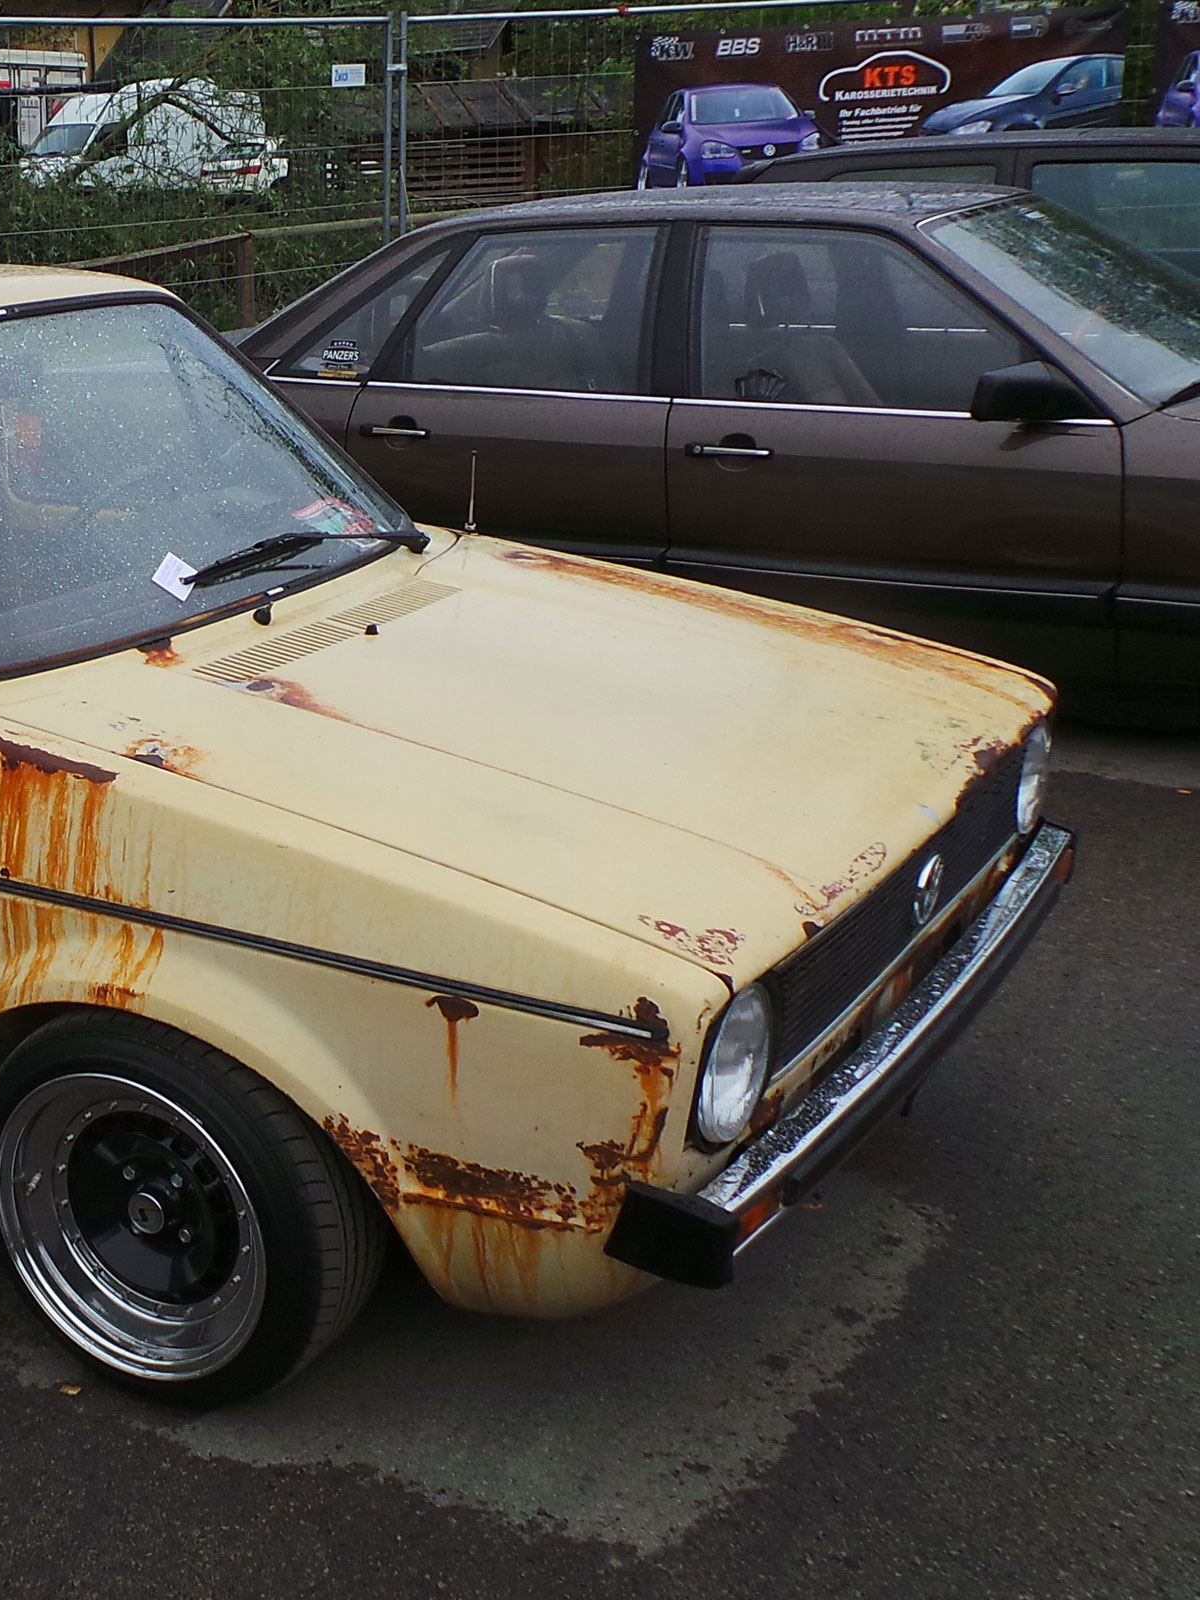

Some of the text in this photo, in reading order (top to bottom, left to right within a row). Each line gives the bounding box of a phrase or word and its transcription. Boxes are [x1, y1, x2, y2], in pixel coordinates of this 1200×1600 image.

[716, 38, 760, 56] BBS
[864, 65, 916, 88] KTS
[834, 85, 938, 101] KAROSSERIETECHNIK
[839, 108, 853, 118] Ihr
[854, 105, 908, 117] Fachbetrieb
